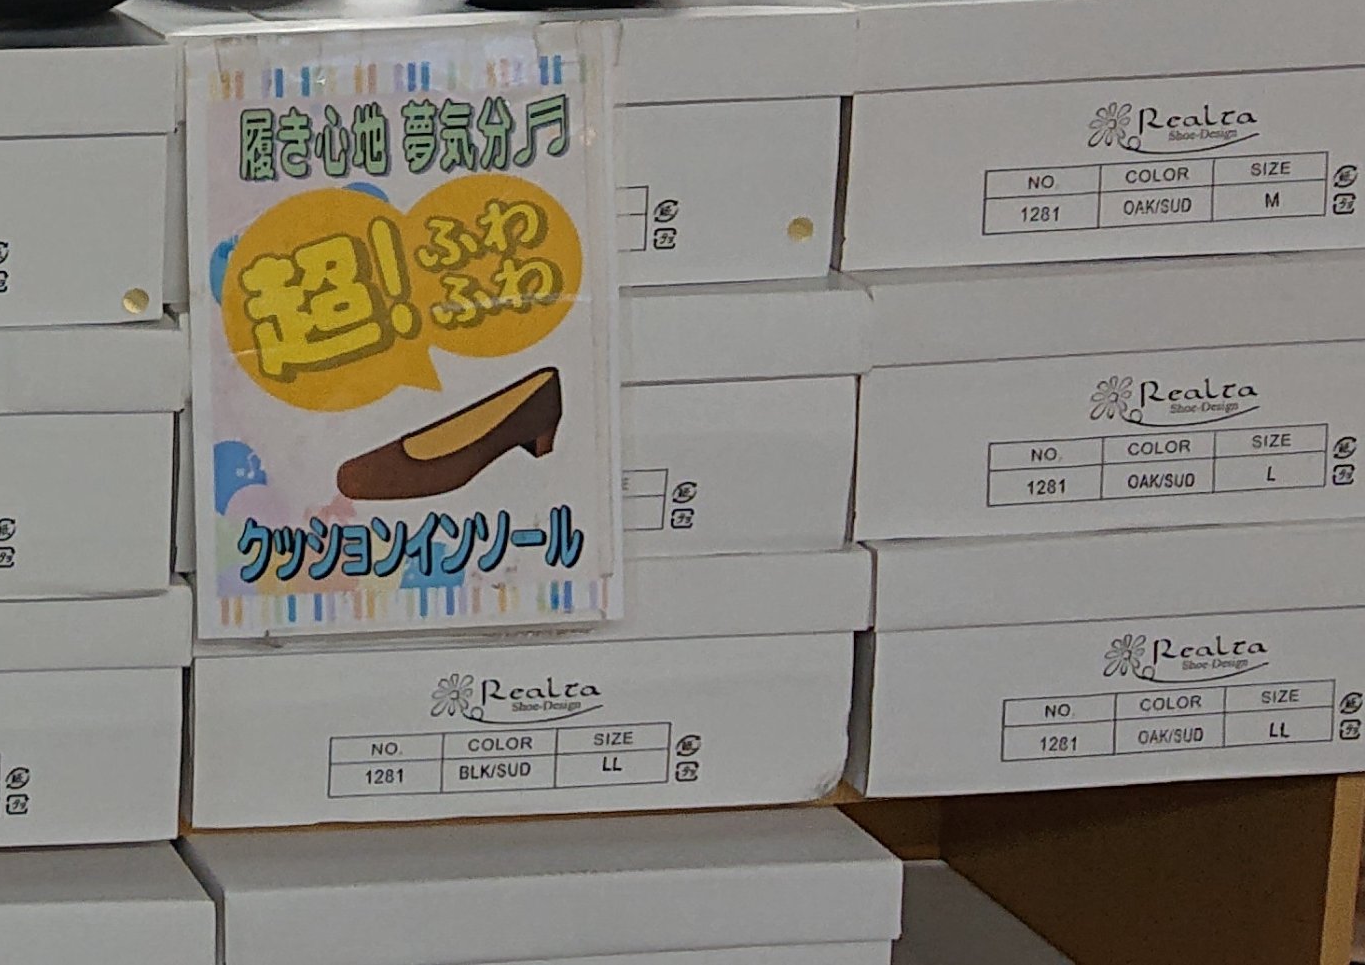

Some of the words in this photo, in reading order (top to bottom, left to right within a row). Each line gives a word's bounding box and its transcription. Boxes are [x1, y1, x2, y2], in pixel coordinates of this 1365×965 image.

[1138, 104, 1258, 136] Realta
[239, 100, 389, 182] 履き心地
[401, 96, 515, 173] 夢気分
[1124, 166, 1190, 185] COLOR
[1250, 160, 1292, 177] SIZE
[1020, 205, 1060, 223] 1281
[1122, 197, 1193, 216] OAK/SUD
[1264, 191, 1280, 209] M
[416, 198, 548, 272] ふわ
[239, 215, 420, 384] 超!
[430, 256, 563, 329] ふわ
[1139, 377, 1259, 409] Realta
[1127, 439, 1191, 457] COLOR
[1251, 432, 1292, 450] SIZE
[1026, 478, 1066, 496] 1281
[1127, 472, 1196, 490] OAK/SUD
[1266, 465, 1277, 483] L
[237, 506, 584, 584] クッションインソール
[1152, 635, 1269, 671] Realta
[480, 676, 603, 707] Realta
[1139, 694, 1202, 713] COLOR
[1261, 688, 1301, 705] SIZE
[467, 736, 533, 753] COLOR
[593, 730, 634, 747] SIZE
[1039, 735, 1078, 752] 1281
[1137, 726, 1204, 746] OAK/SUD
[1268, 721, 1291, 739] LL
[365, 767, 404, 785] 1281
[458, 761, 532, 781] BLK/SUD
[601, 755, 623, 772] LL
